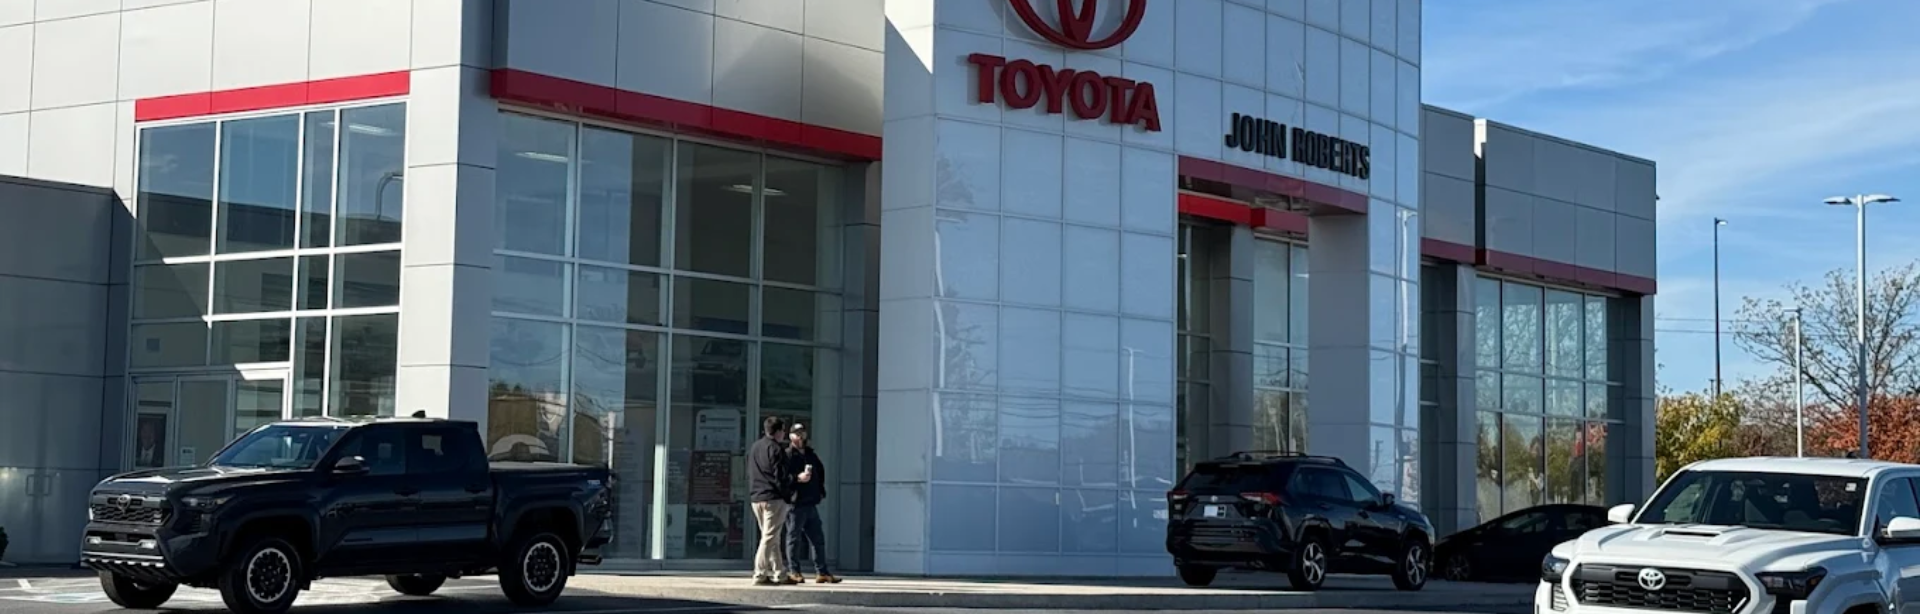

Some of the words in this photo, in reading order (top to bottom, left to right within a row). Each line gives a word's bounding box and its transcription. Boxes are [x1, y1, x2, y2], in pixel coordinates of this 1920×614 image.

[968, 53, 1161, 132] TOYOTA
[1225, 112, 1287, 159] JOHN
[1291, 127, 1371, 180] ROBERTS
